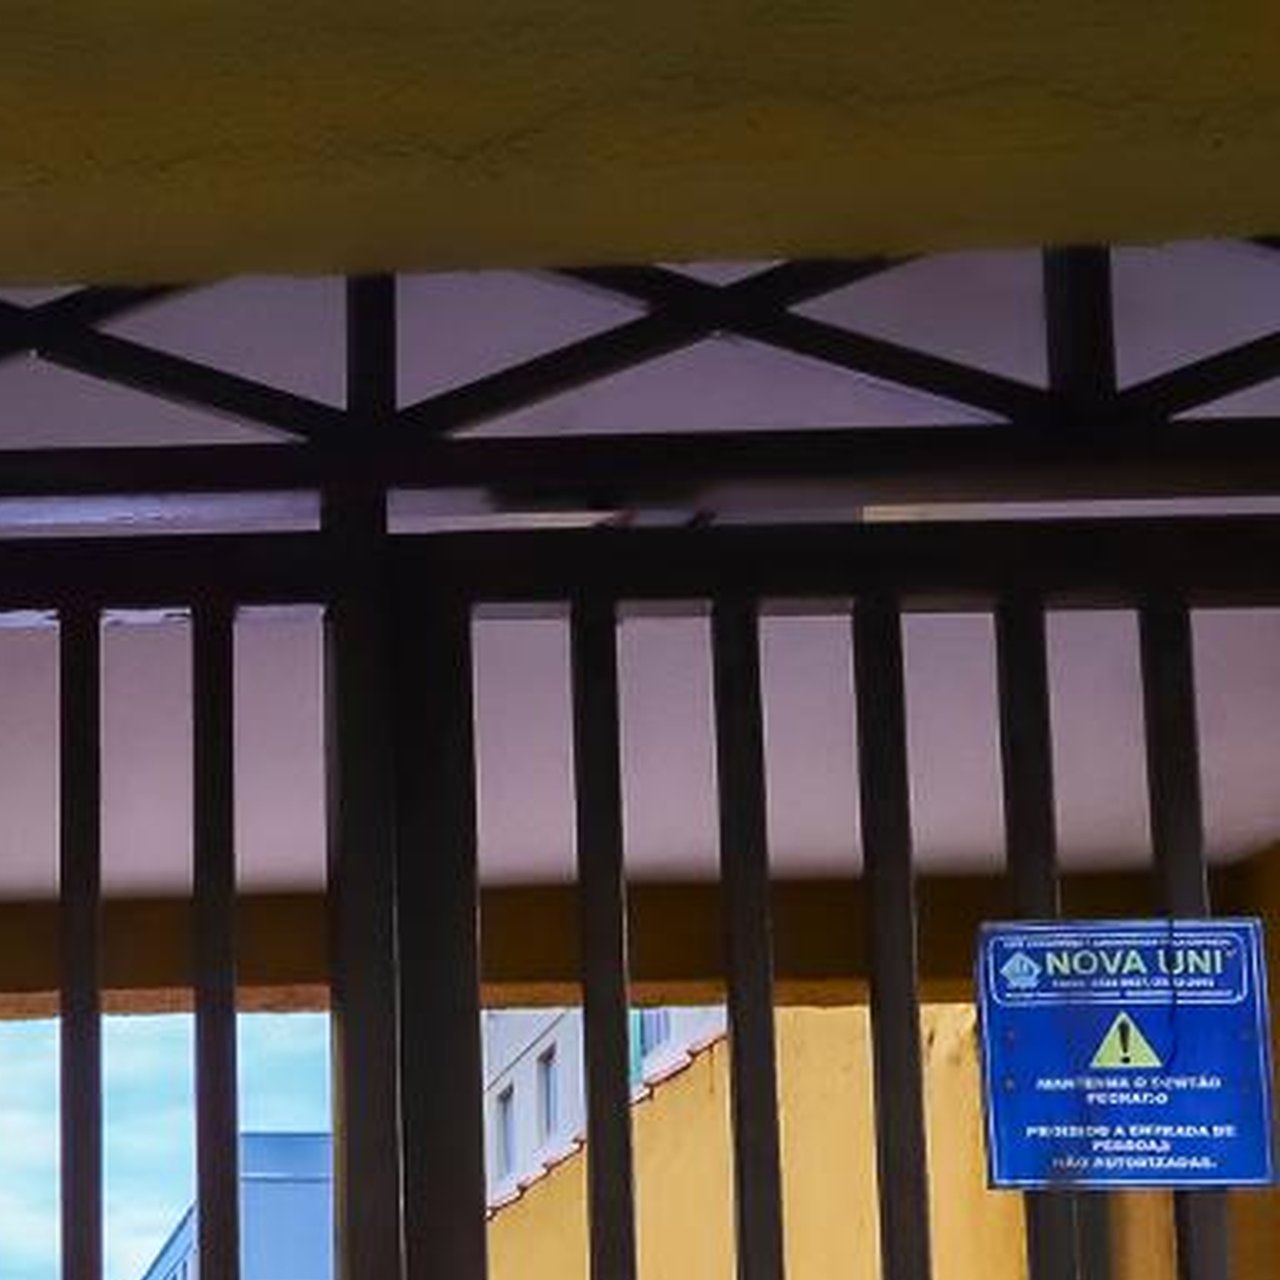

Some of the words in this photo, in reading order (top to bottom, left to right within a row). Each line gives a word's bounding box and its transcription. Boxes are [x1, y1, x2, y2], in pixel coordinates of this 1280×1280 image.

[1045, 949, 1148, 976] NOVA
[1158, 949, 1224, 975] UNI
[1113, 1126, 1127, 1138] A
